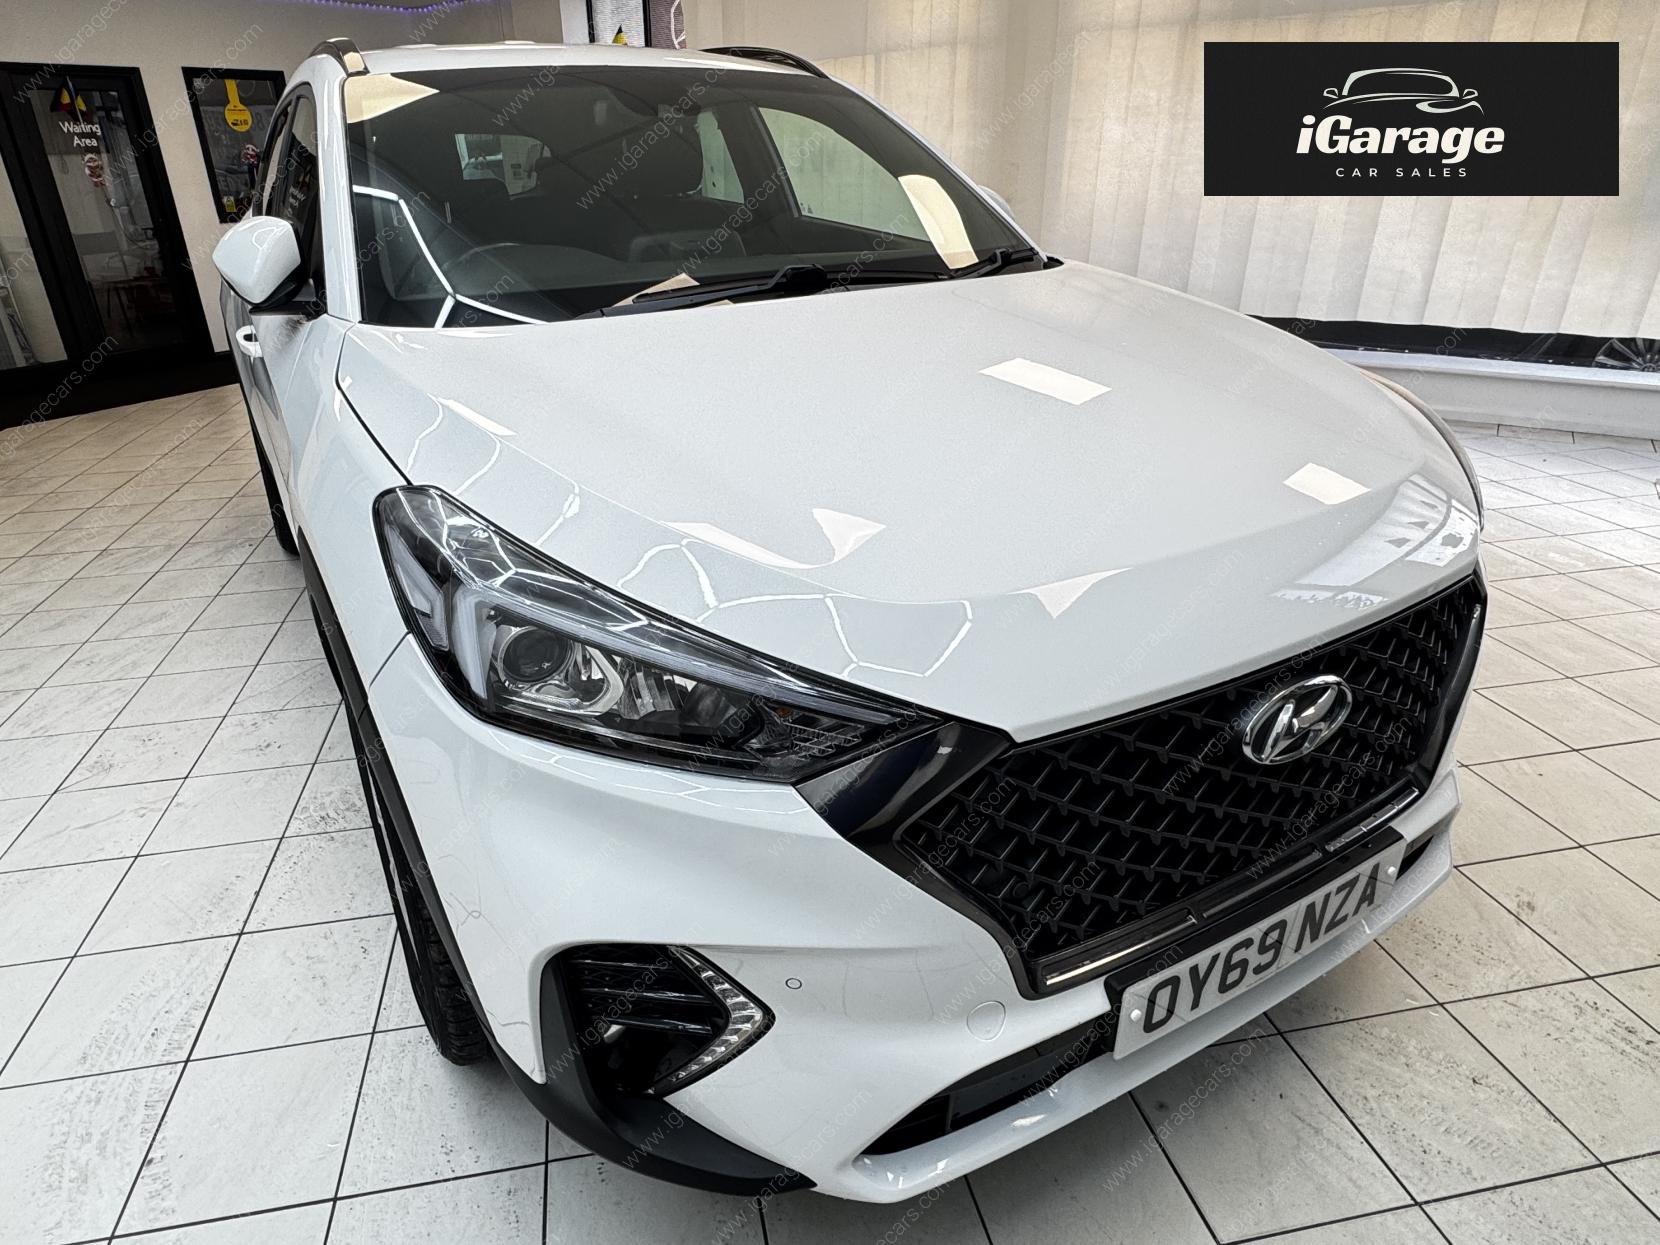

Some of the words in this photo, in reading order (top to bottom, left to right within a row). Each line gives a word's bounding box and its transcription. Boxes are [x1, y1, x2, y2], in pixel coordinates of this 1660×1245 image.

[59, 121, 101, 135] Waiting
[73, 136, 98, 147] Area
[1143, 919, 1287, 1033] OY69
[1295, 863, 1380, 953] NZA
